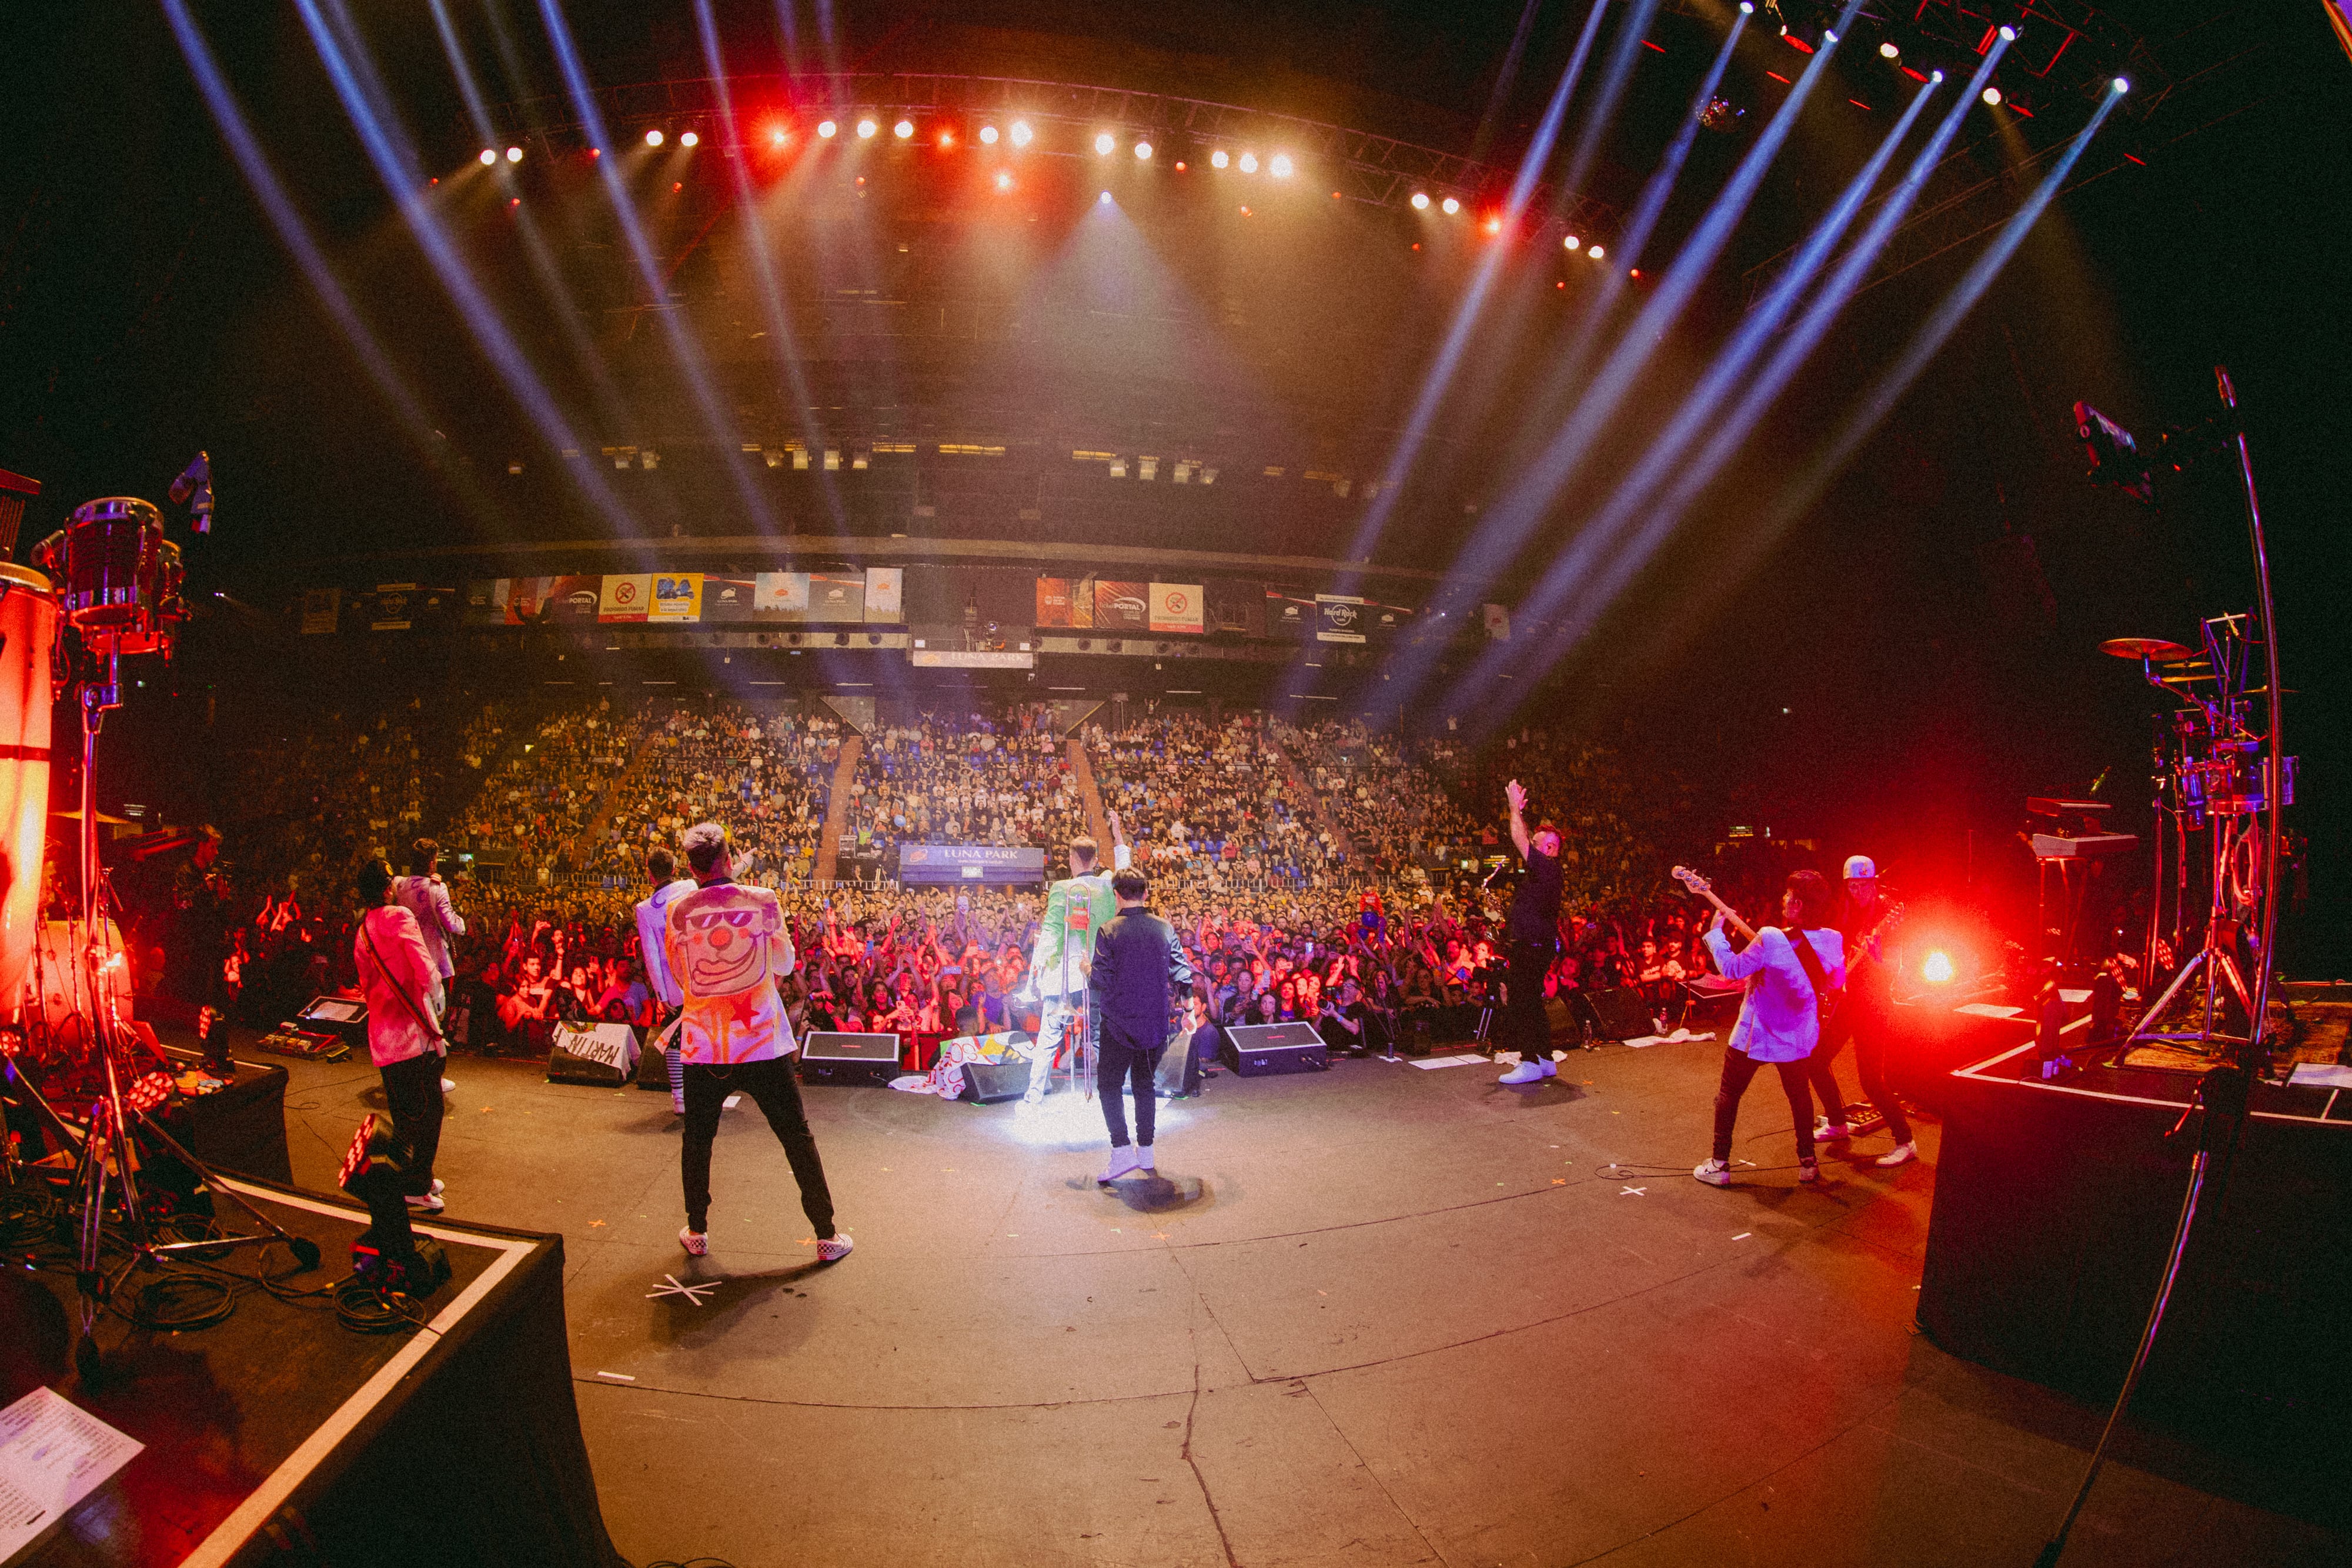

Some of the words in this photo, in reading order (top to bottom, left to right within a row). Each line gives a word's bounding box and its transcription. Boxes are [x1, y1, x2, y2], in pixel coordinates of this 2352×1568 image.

[1324, 608, 1341, 616] Hard
[1341, 609, 1358, 619] Rock
[951, 652, 985, 661] LUNA
[991, 653, 1024, 661] PARK
[944, 848, 981, 858] LUNA
[985, 850, 1018, 859] PARK
[567, 1034, 620, 1065] MARTIN
